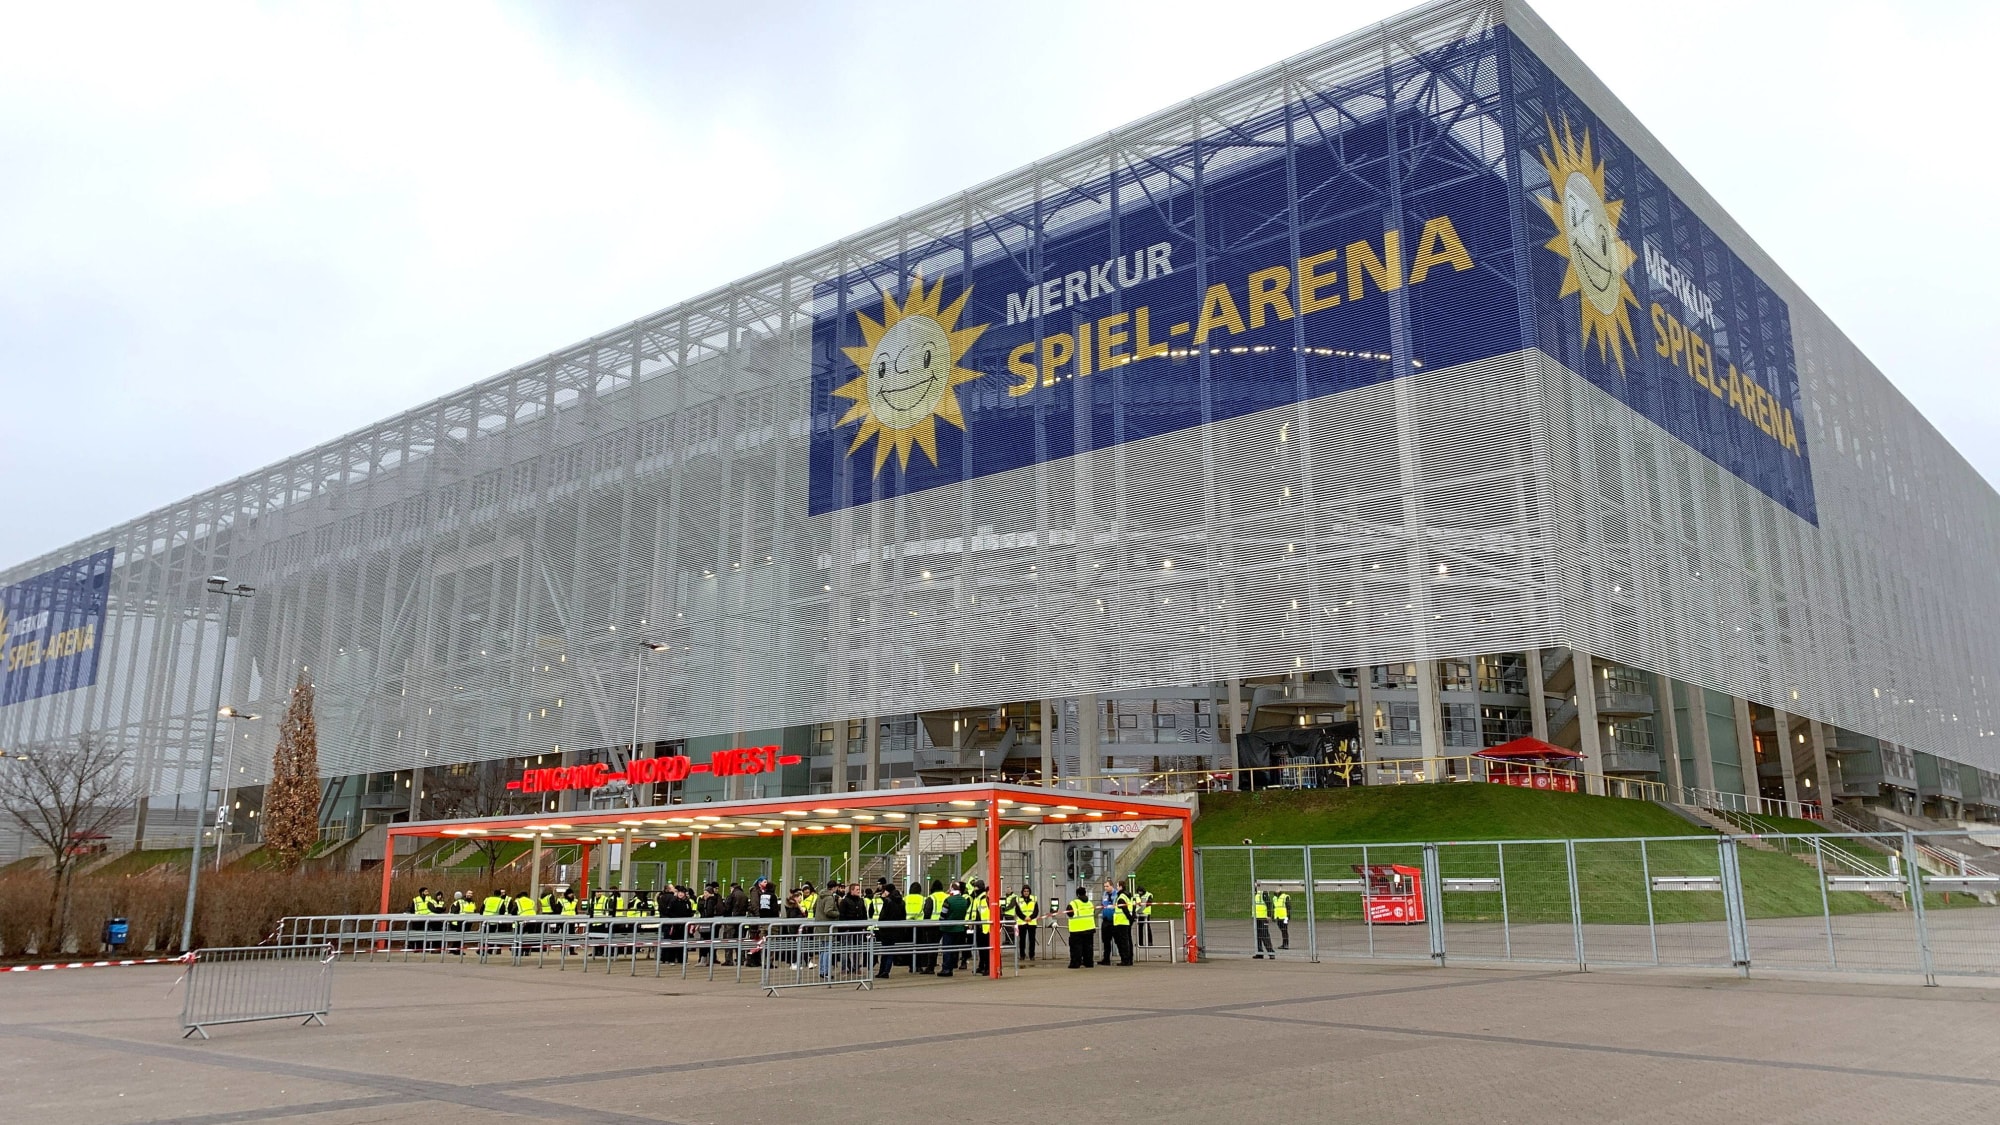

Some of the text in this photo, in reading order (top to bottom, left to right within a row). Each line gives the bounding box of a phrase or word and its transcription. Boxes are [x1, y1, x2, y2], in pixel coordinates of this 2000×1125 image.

[1006, 242, 1173, 325] MERKUR
[1007, 215, 1475, 397] SPIEL-ARENA
[1643, 238, 1716, 329] MERKUR
[1651, 302, 1800, 457] SPIEL-ARENA
[7, 623, 94, 672] SPIEL-ARENA
[522, 763, 608, 793] EINGANG
